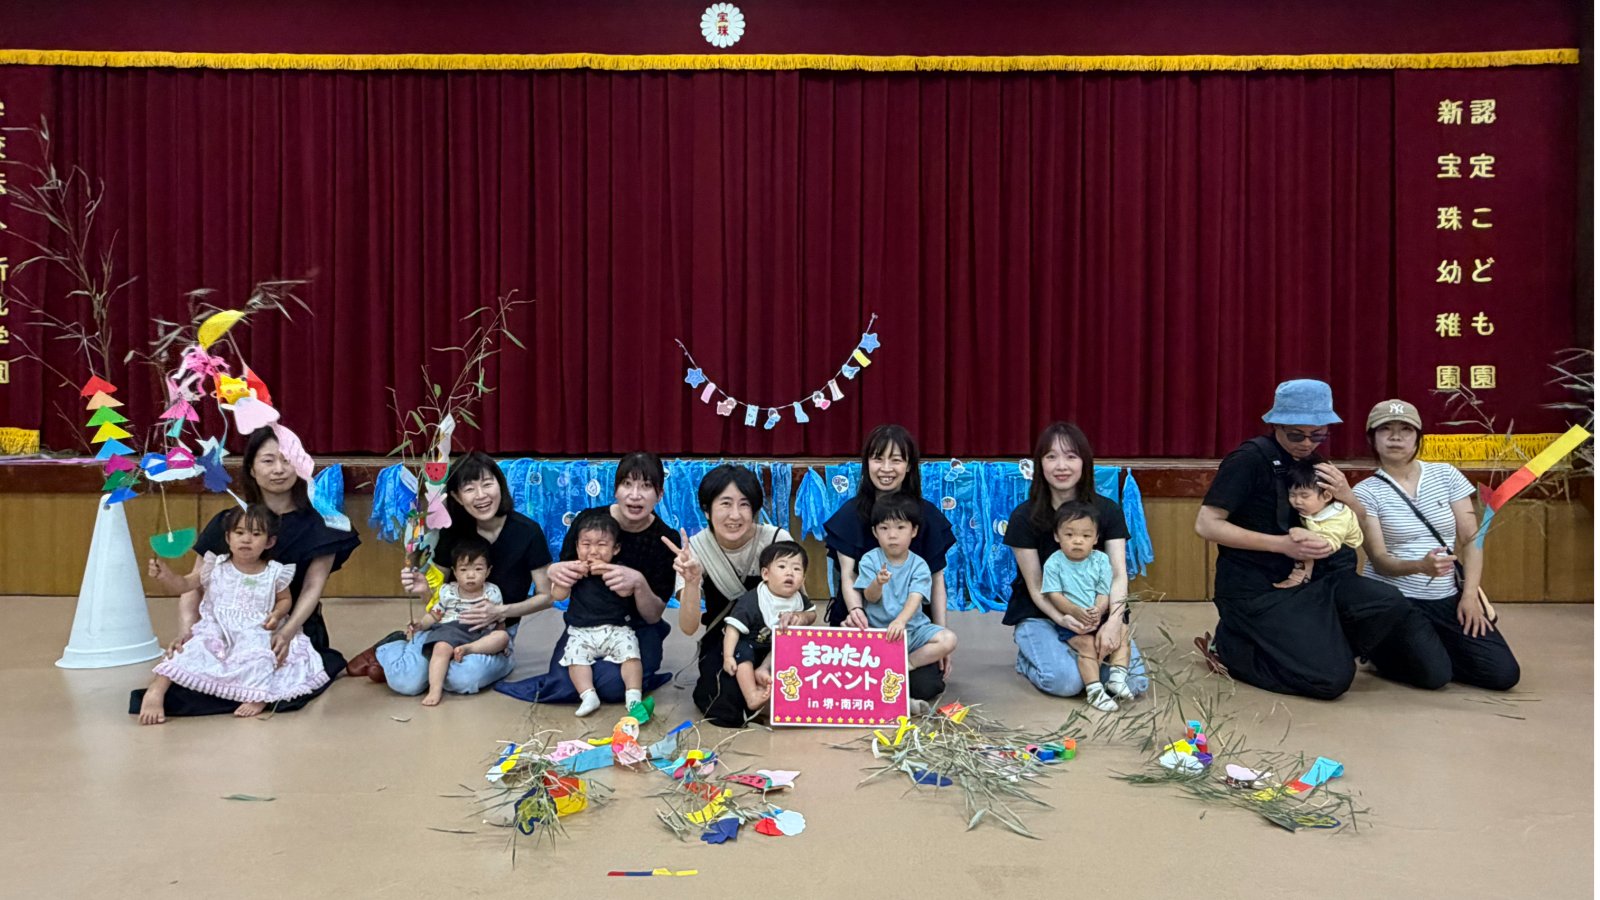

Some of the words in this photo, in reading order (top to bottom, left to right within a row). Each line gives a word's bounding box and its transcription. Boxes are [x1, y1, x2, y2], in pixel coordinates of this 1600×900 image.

[1435, 98, 1463, 389] 新宝珠幼稚園
[1469, 98, 1497, 389] 認定こども園
[801, 641, 880, 668] まみたん
[804, 670, 878, 691] イベント
[807, 698, 819, 708] in
[823, 698, 874, 711] 堺・南河内
